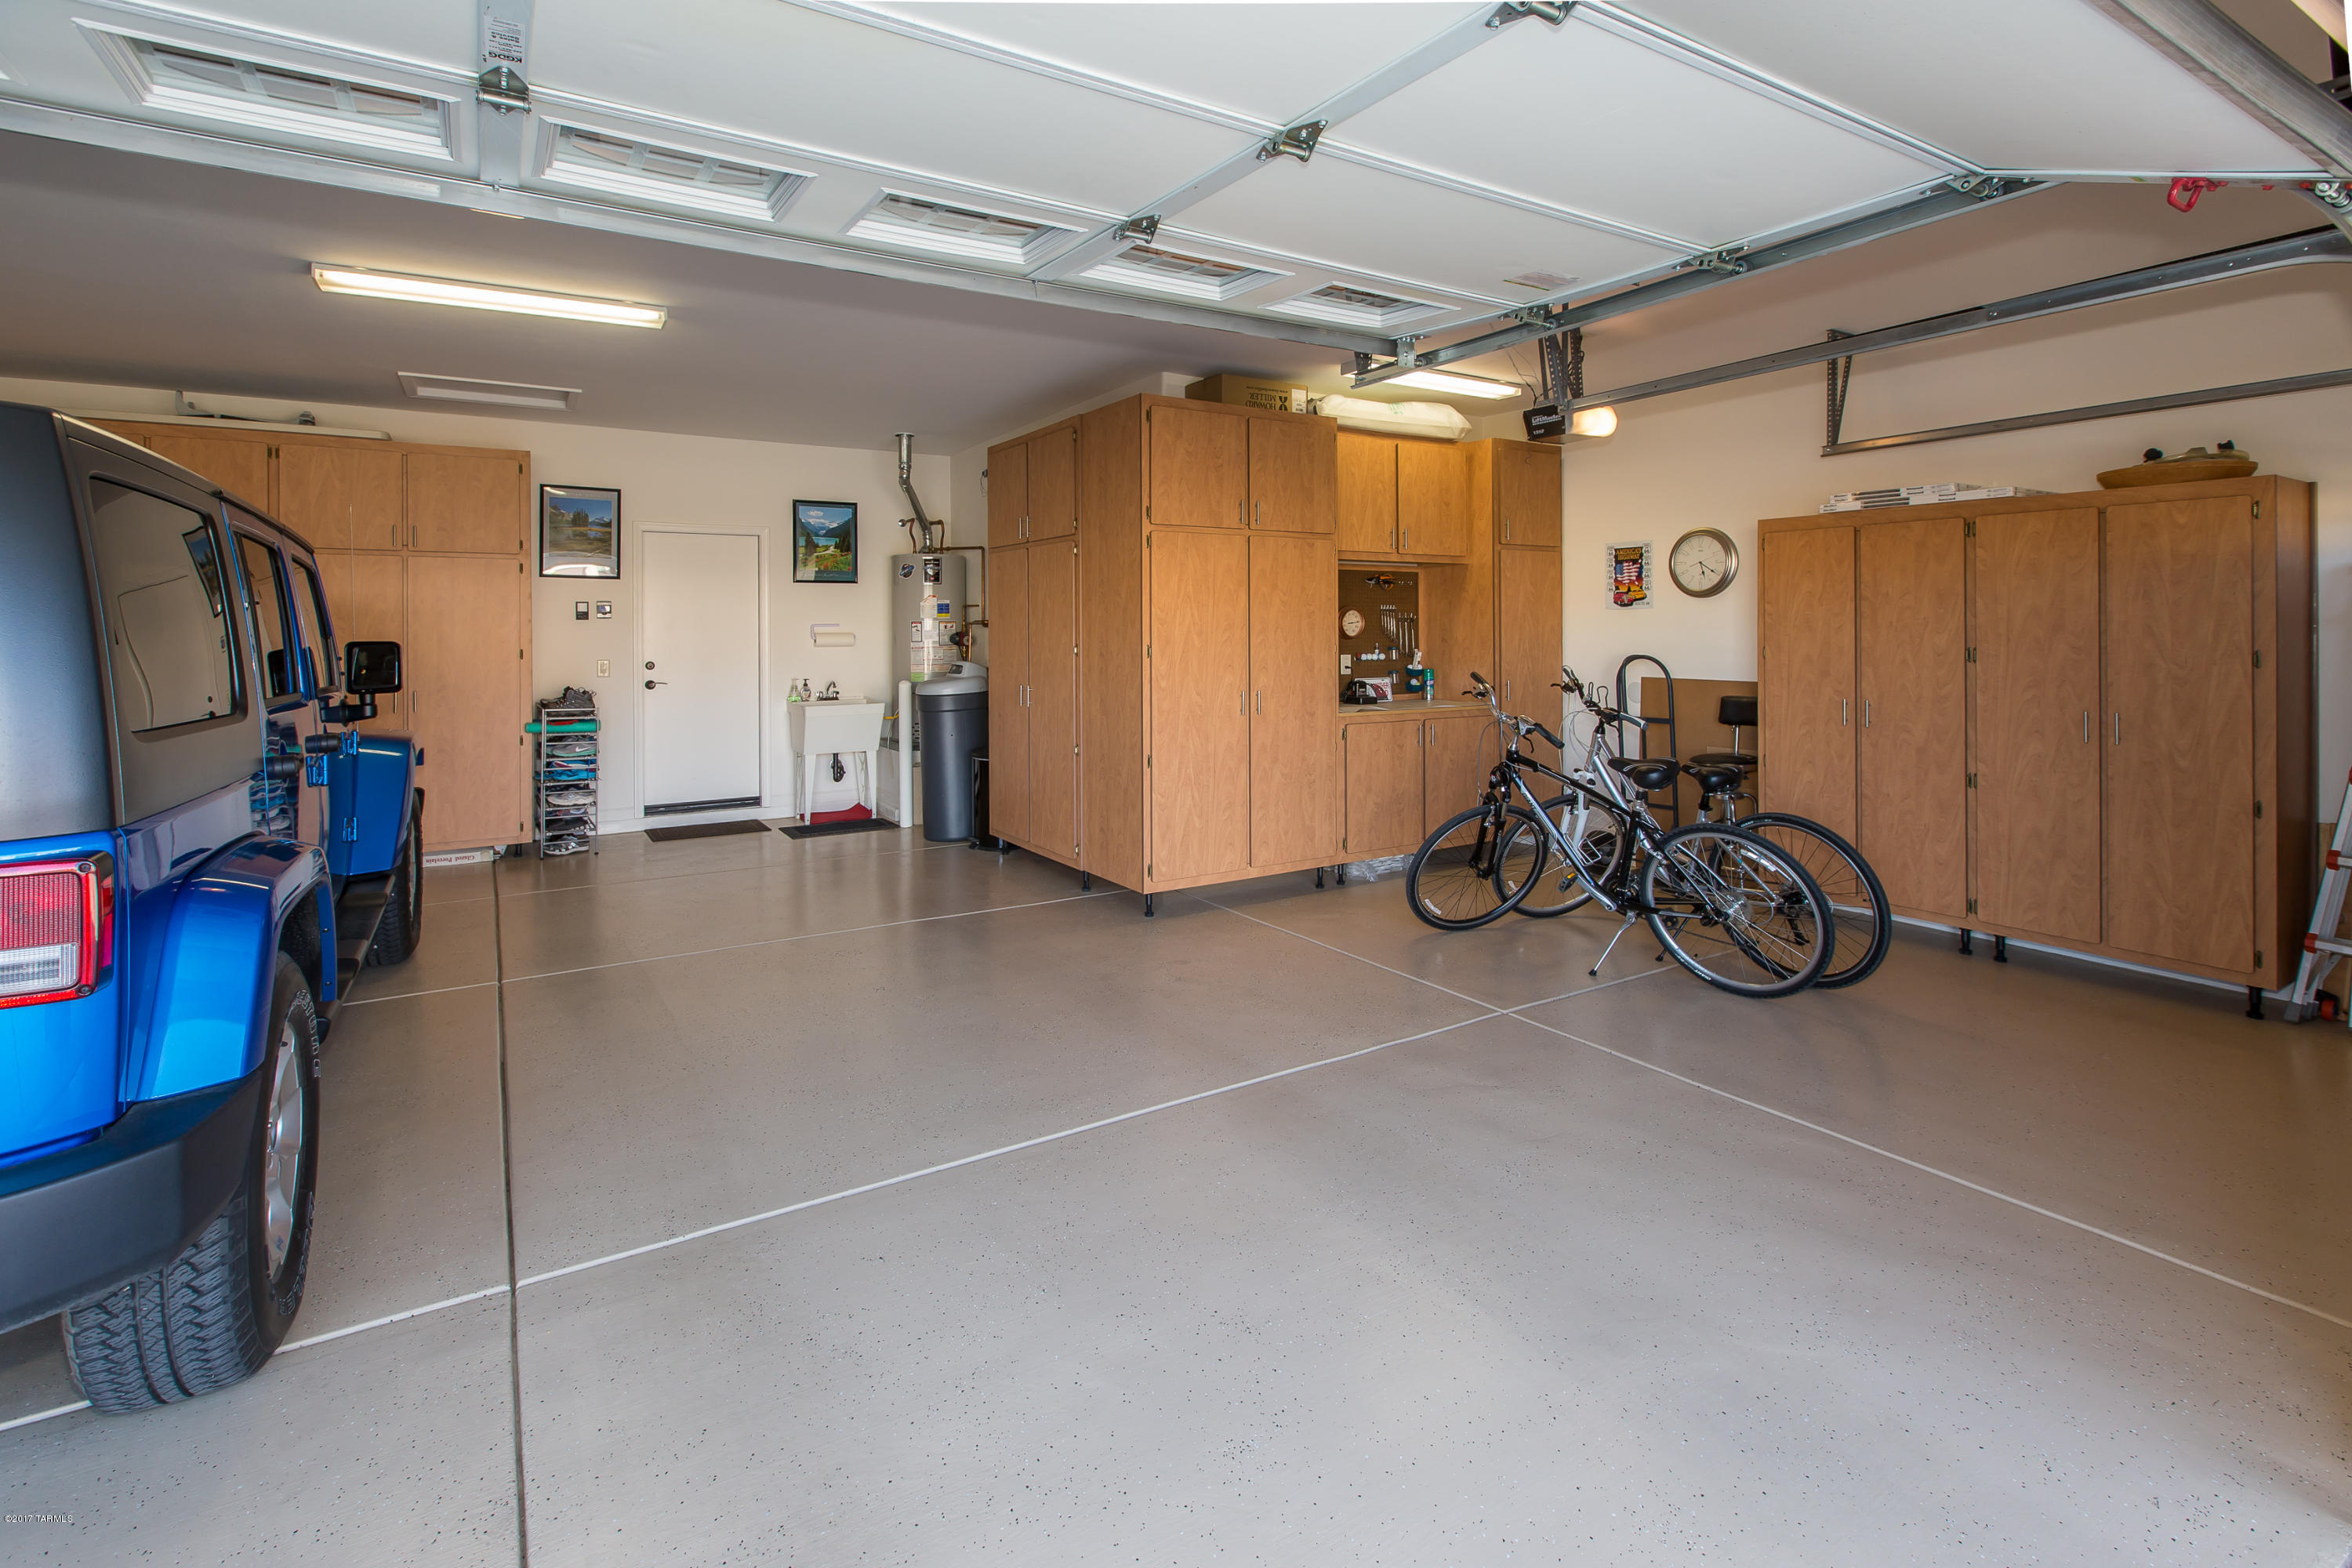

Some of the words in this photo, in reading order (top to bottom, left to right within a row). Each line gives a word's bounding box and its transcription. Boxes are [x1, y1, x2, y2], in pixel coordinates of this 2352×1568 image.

[488, 51, 523, 63] KGDG
[1248, 393, 1276, 402] MILLER
[1245, 401, 1276, 411] HOWARD
[1693, 968, 1711, 982] GIANT
